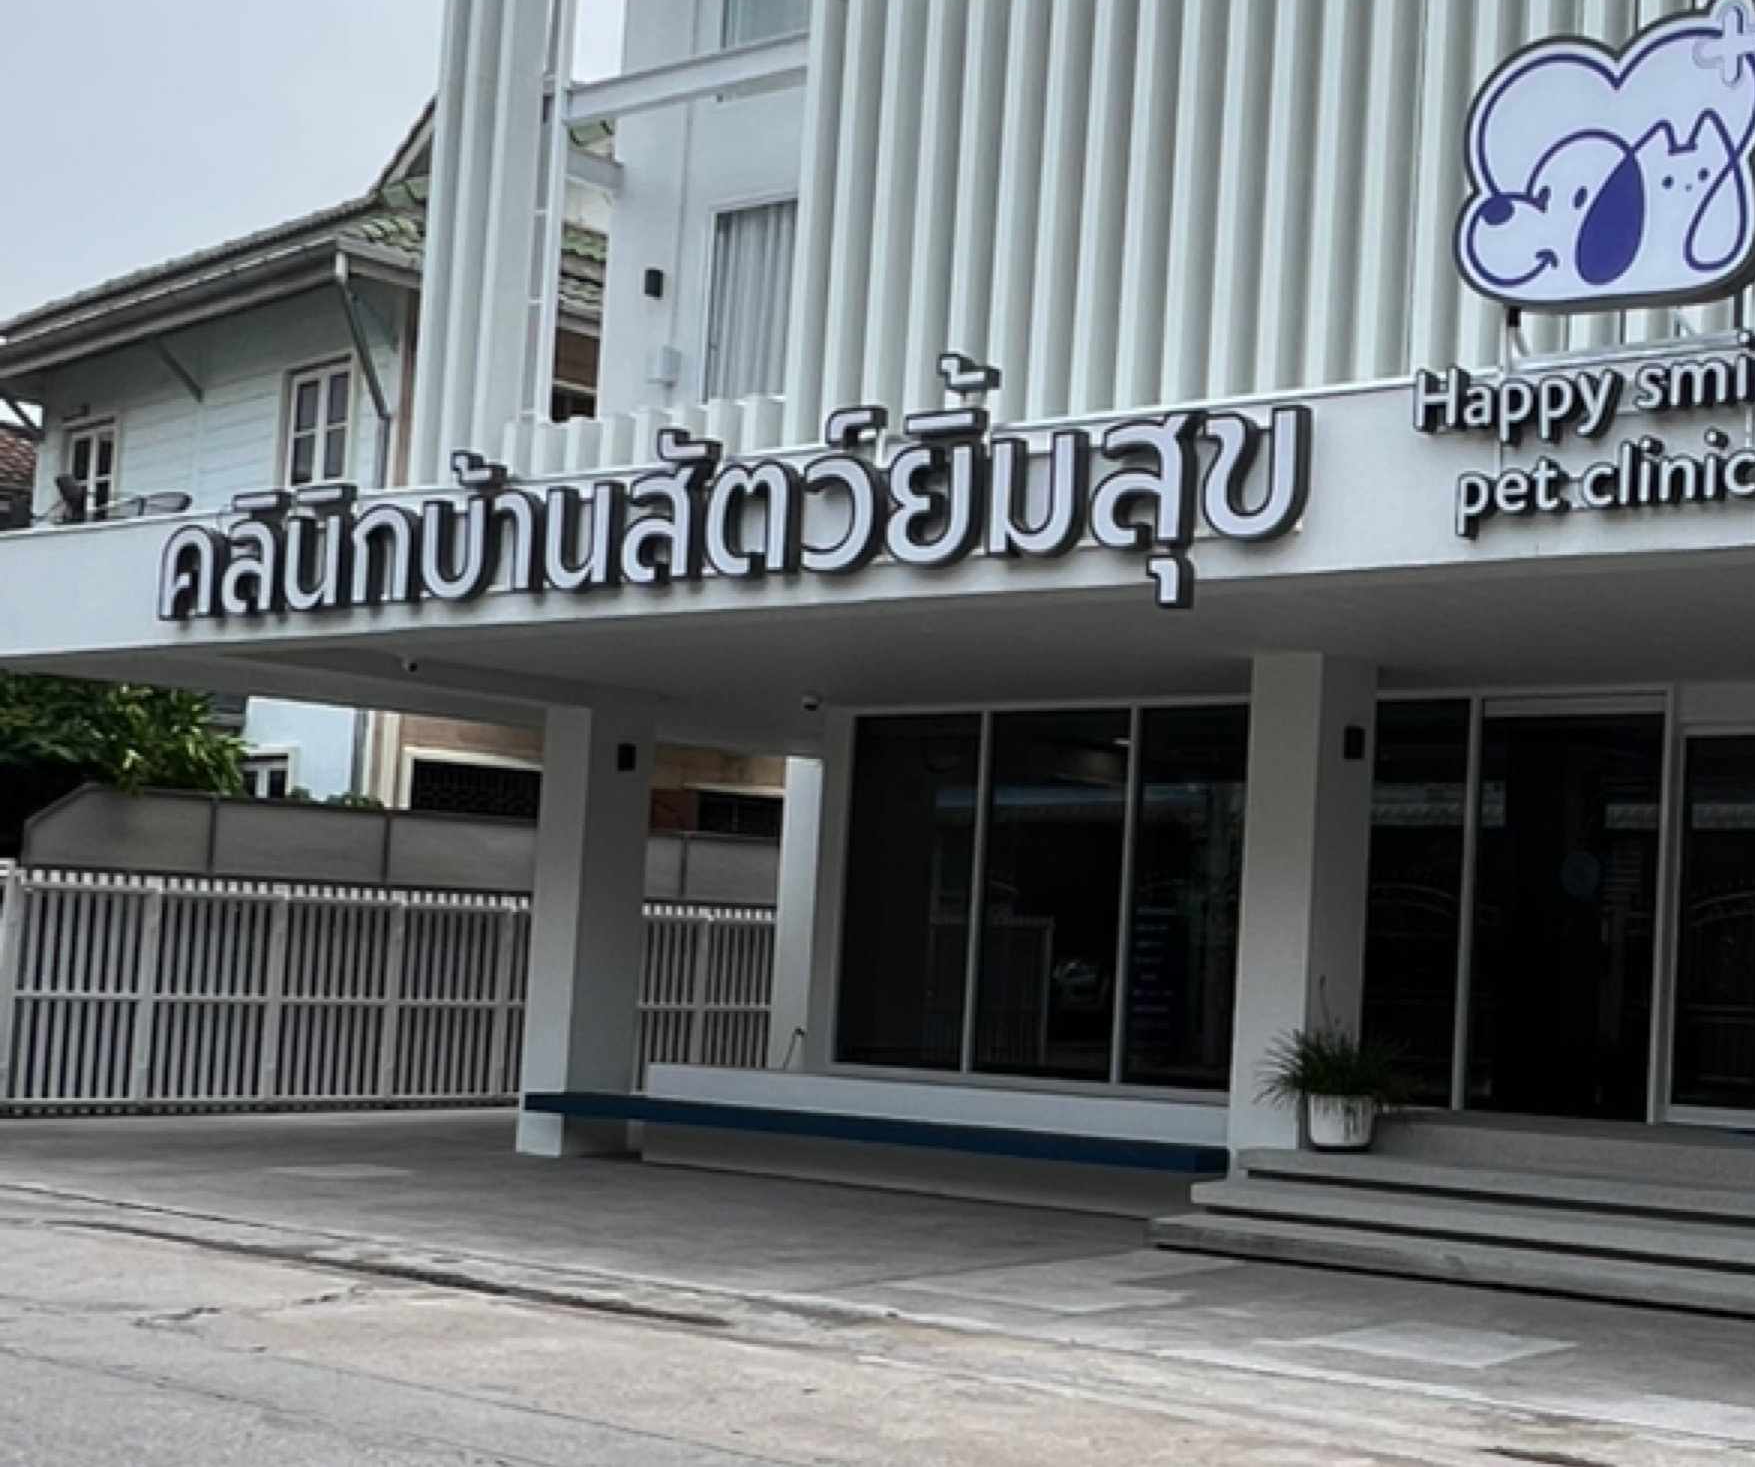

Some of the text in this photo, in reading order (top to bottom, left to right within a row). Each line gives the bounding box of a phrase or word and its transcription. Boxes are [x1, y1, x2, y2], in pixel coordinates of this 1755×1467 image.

[1414, 366, 1622, 447] Happy
[157, 352, 1312, 620] คลินิกบ้านสัตว์ยิ้มสุข
[1455, 456, 1572, 540] pet
